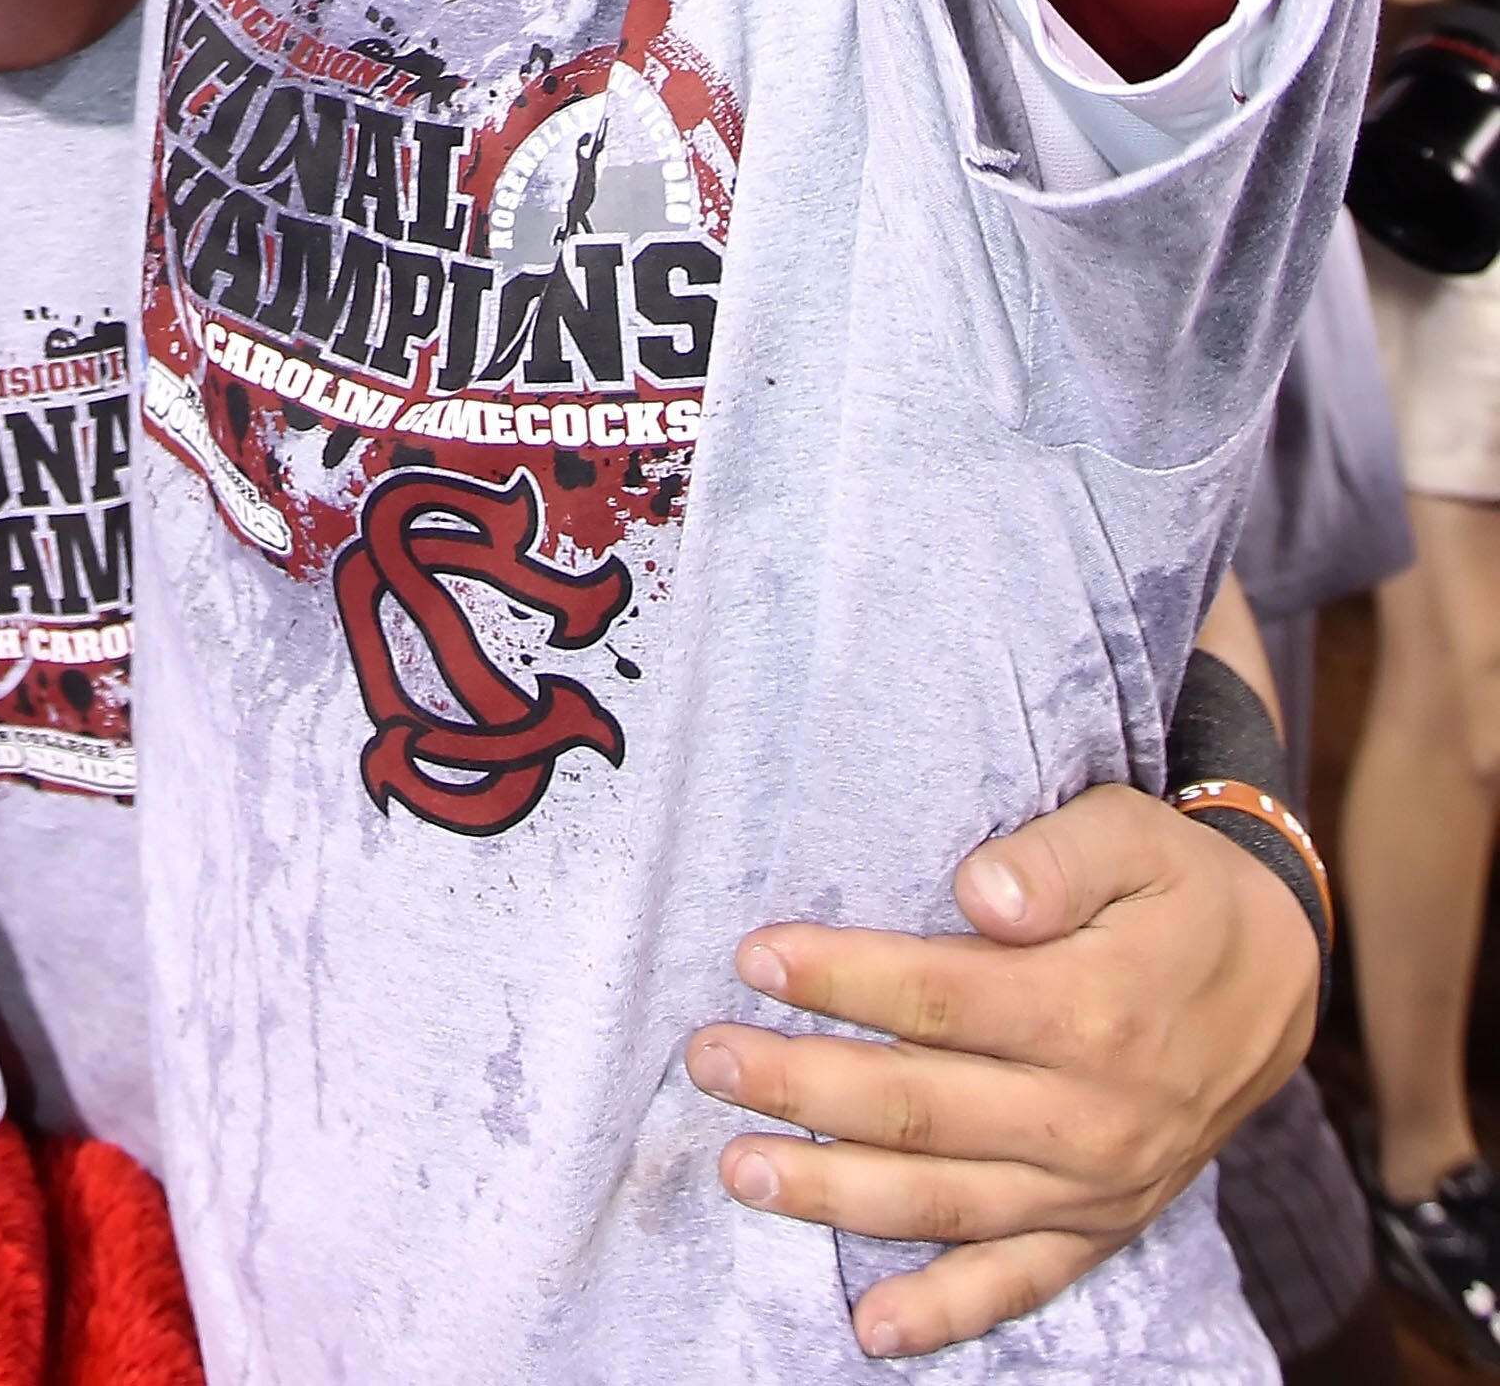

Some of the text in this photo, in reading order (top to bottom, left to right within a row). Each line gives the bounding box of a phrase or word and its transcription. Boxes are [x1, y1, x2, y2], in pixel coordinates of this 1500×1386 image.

[166, 146, 724, 393] HAMPIONS
[105, 351, 124, 382] I
[203, 321, 701, 447] CAROLINA GAMECOCKS
[28, 622, 135, 664] CARO
